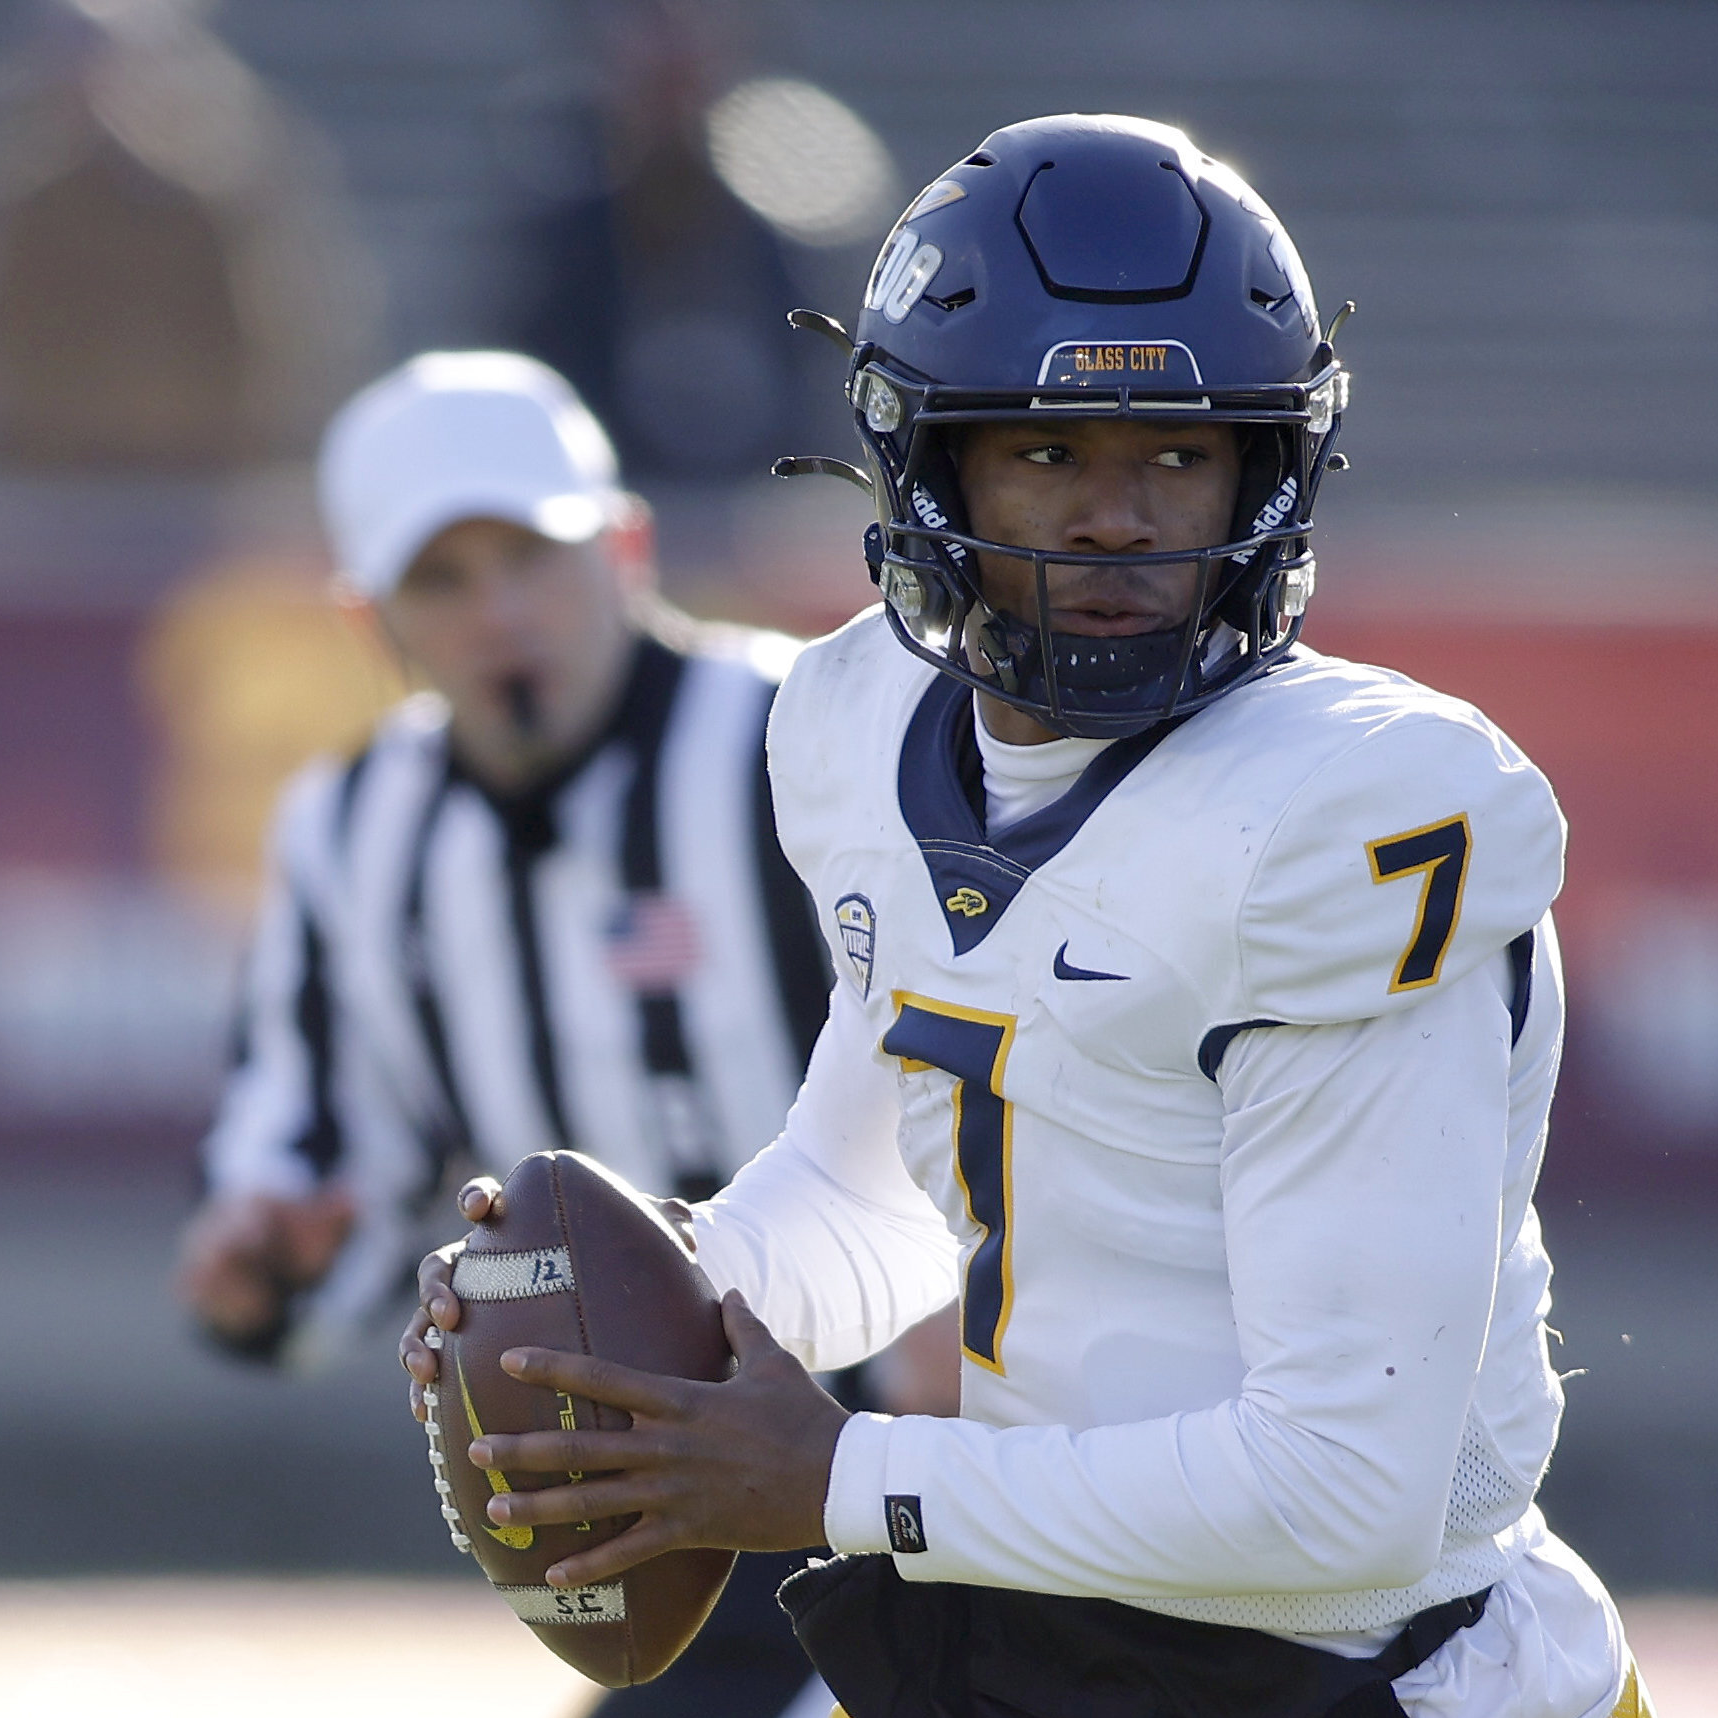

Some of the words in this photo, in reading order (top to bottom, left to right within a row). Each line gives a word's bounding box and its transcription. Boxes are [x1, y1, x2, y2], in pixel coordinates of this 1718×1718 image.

[1074, 347, 1124, 371] GLASS
[1130, 347, 1167, 371] CITY
[1364, 811, 1473, 996] 7
[879, 989, 1018, 1378] 7
